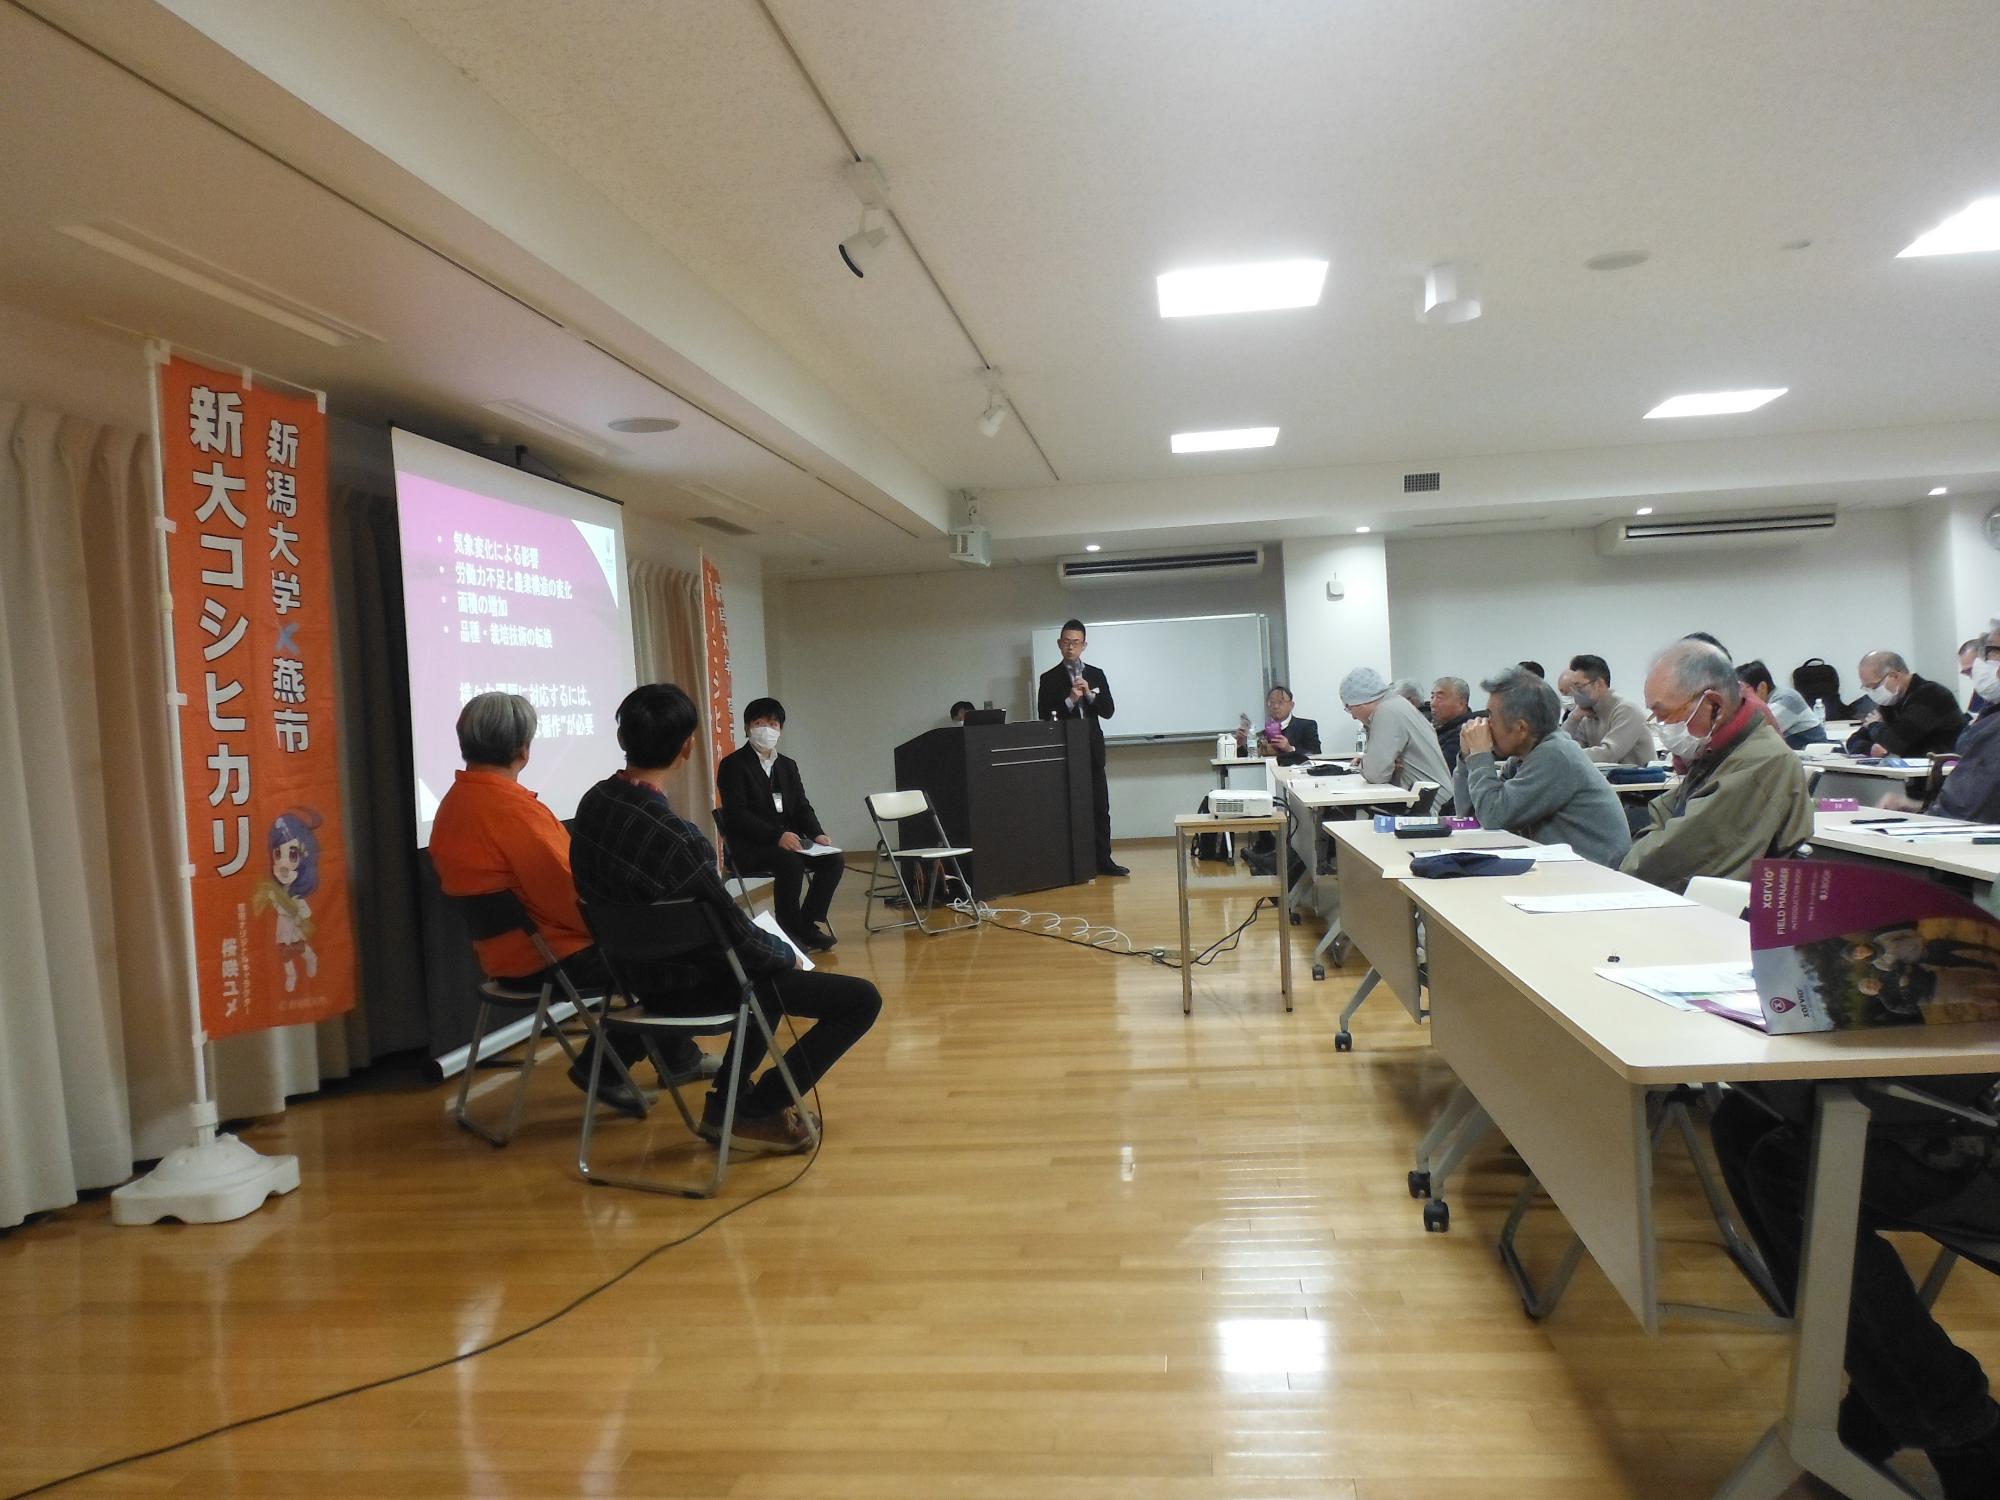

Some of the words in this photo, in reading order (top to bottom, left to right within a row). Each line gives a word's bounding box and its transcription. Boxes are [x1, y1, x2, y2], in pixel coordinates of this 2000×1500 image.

[189, 386, 251, 878] 新大コシヒカリ
[1778, 867, 1790, 909] MANAGER
[1776, 910, 1786, 935] FIELD
